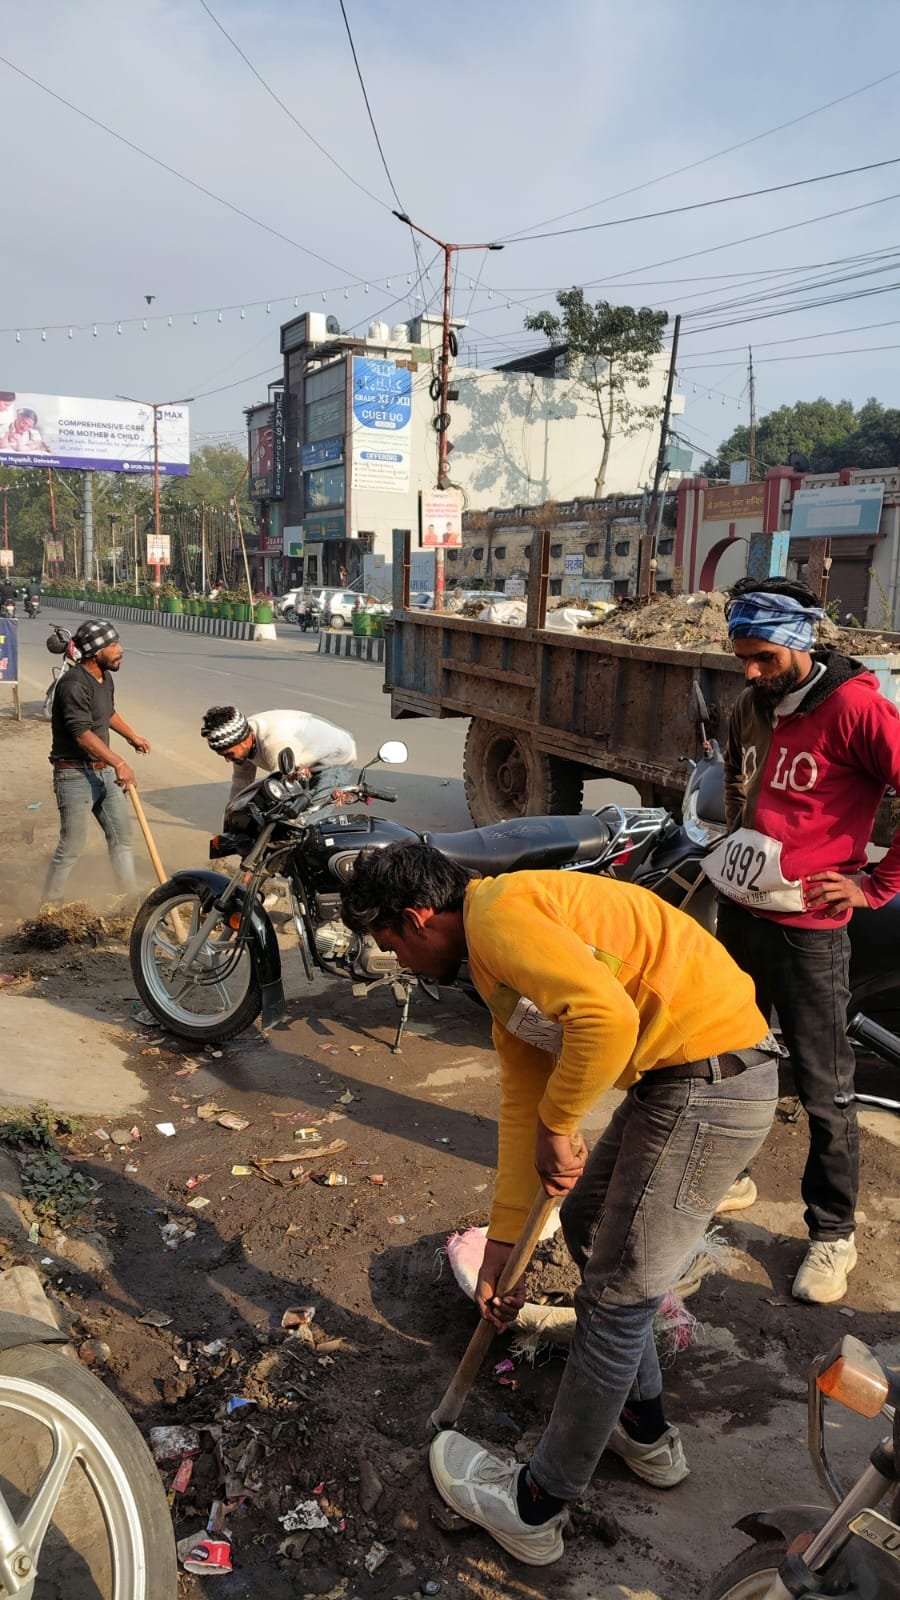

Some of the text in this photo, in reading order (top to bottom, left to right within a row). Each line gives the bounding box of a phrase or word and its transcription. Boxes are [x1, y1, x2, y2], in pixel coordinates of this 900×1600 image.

[164, 410, 183, 419] MAX
[275, 393, 283, 436] JEANS
[361, 410, 404, 422] CUET UG
[58, 419, 145, 432] COMPREHENSIVE CARE
[76, 430, 109, 438] MOTHER
[117, 433, 140, 441] CHILD
[721, 840, 767, 891] 1992
